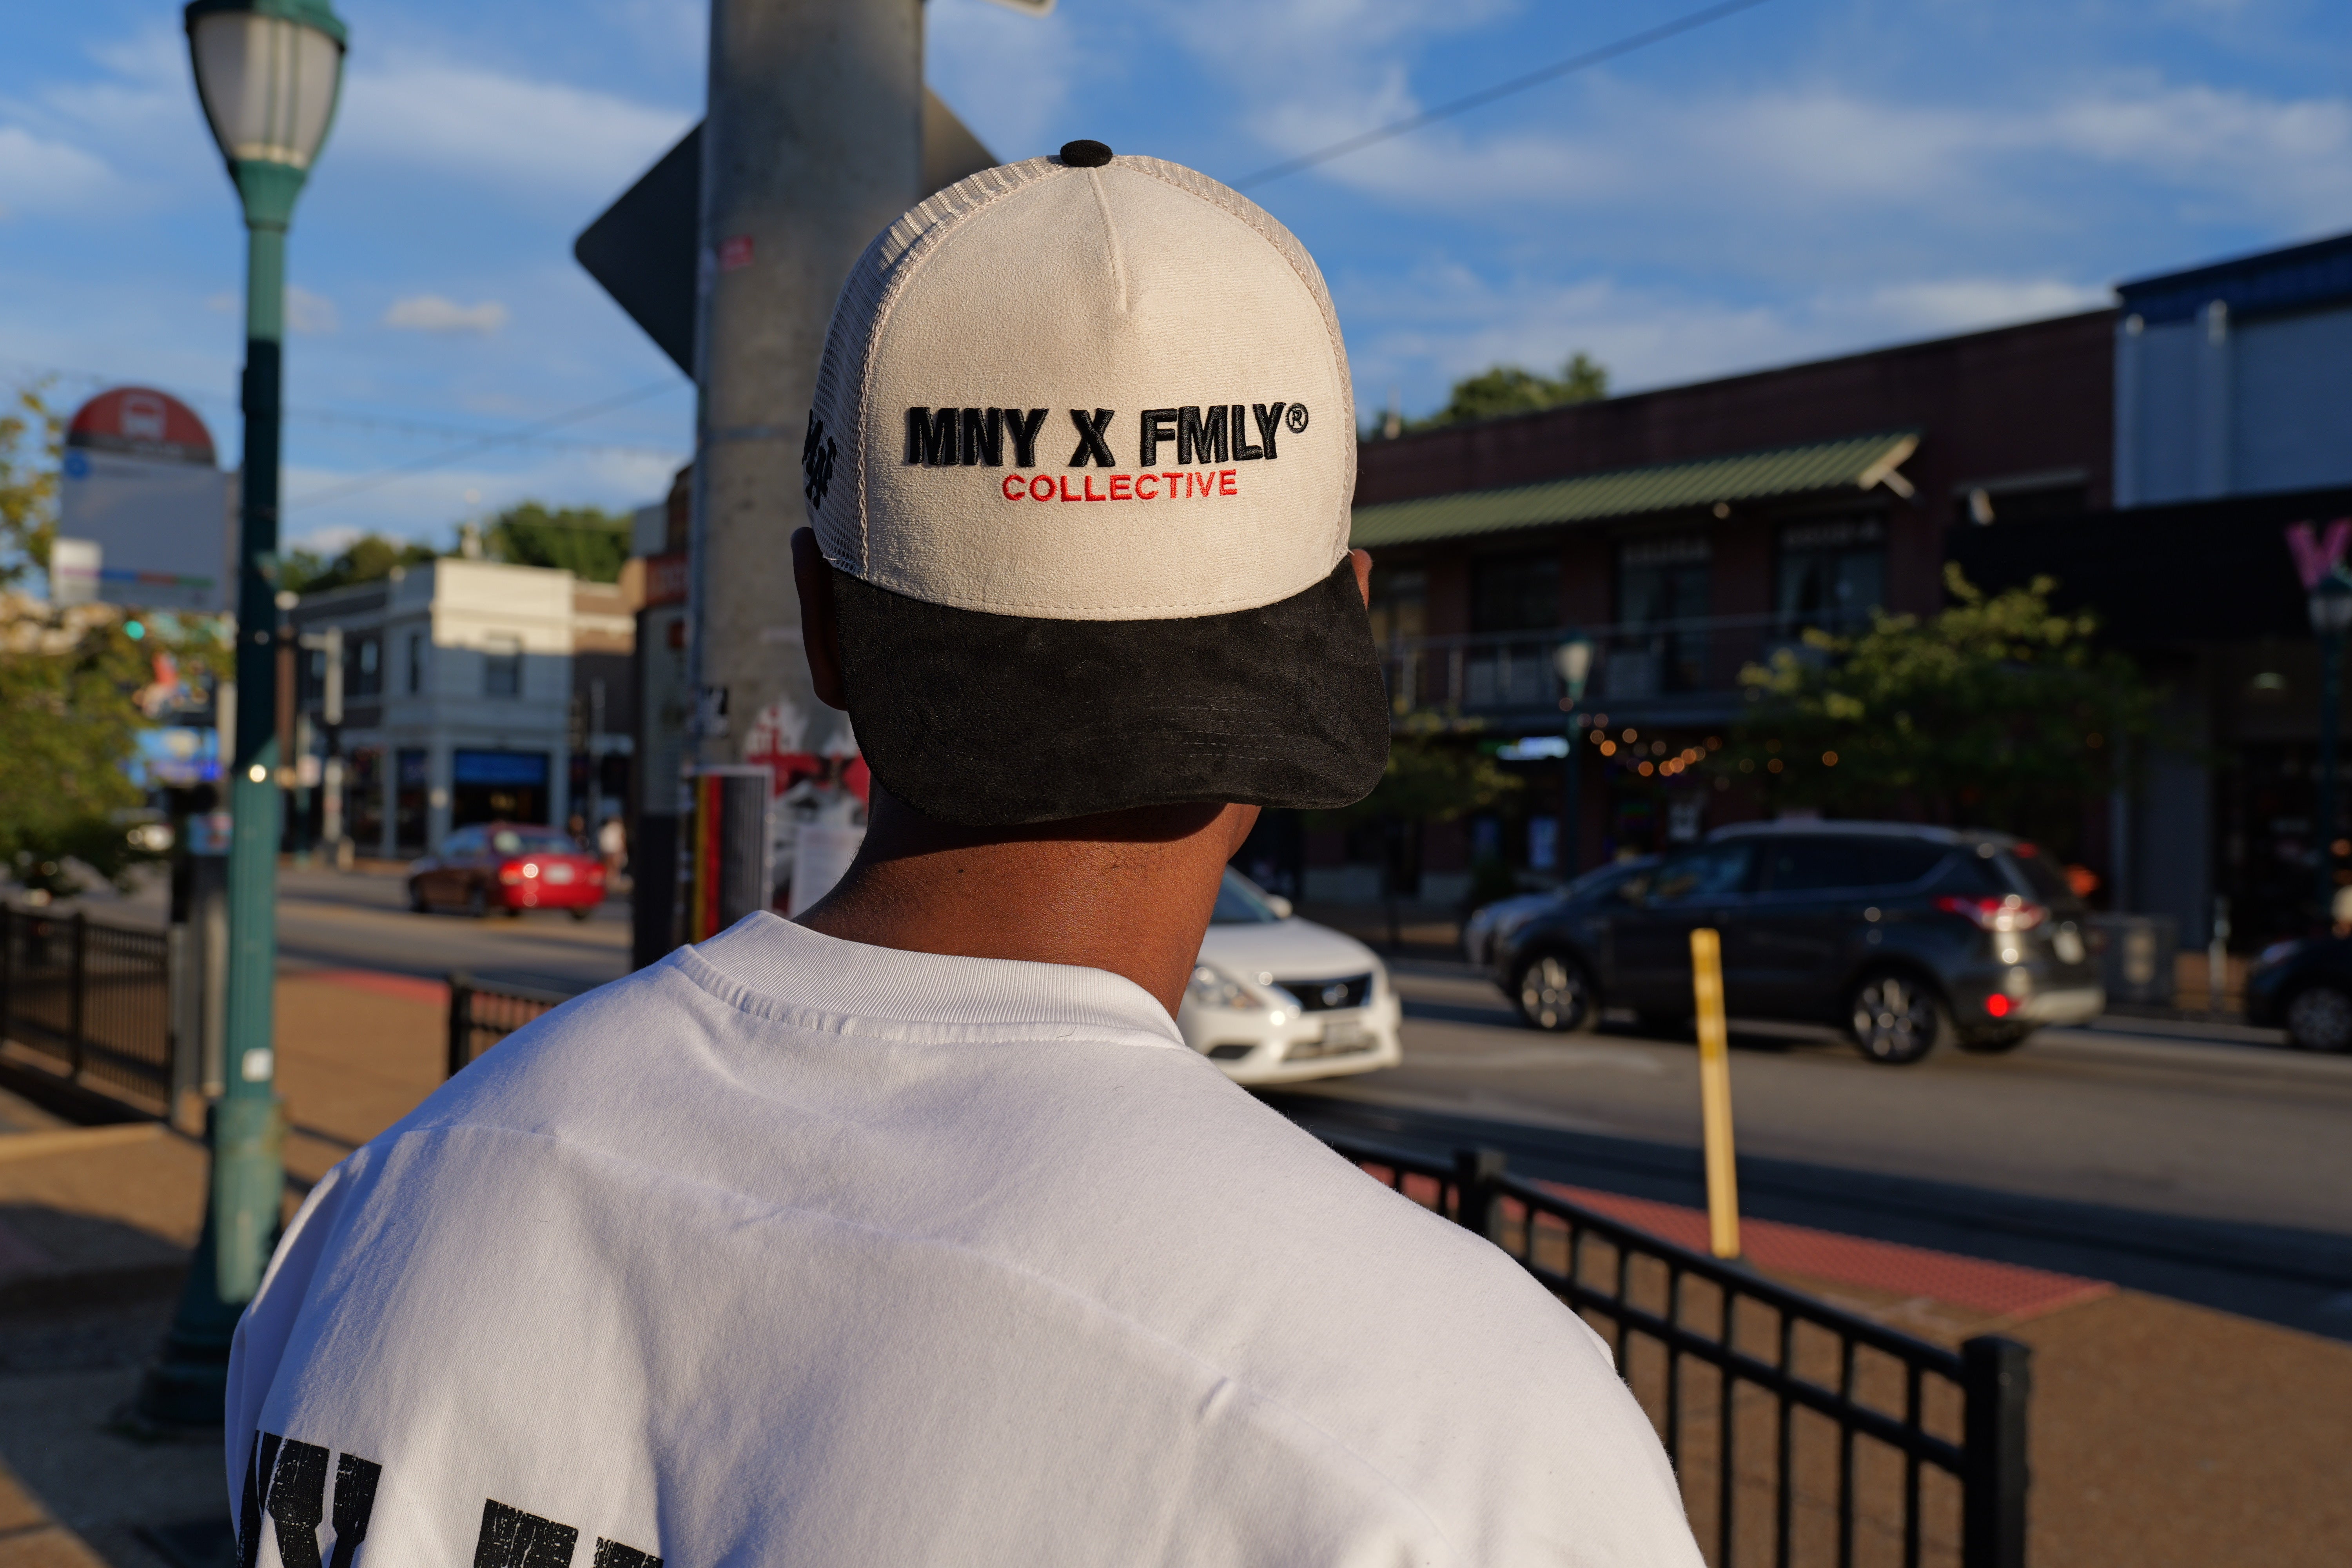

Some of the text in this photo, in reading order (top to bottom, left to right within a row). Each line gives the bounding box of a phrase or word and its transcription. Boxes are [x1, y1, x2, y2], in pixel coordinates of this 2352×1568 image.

[908, 406, 1048, 467] MNY
[1069, 408, 1116, 468] X
[1002, 469, 1238, 502] COLLECTIVE
